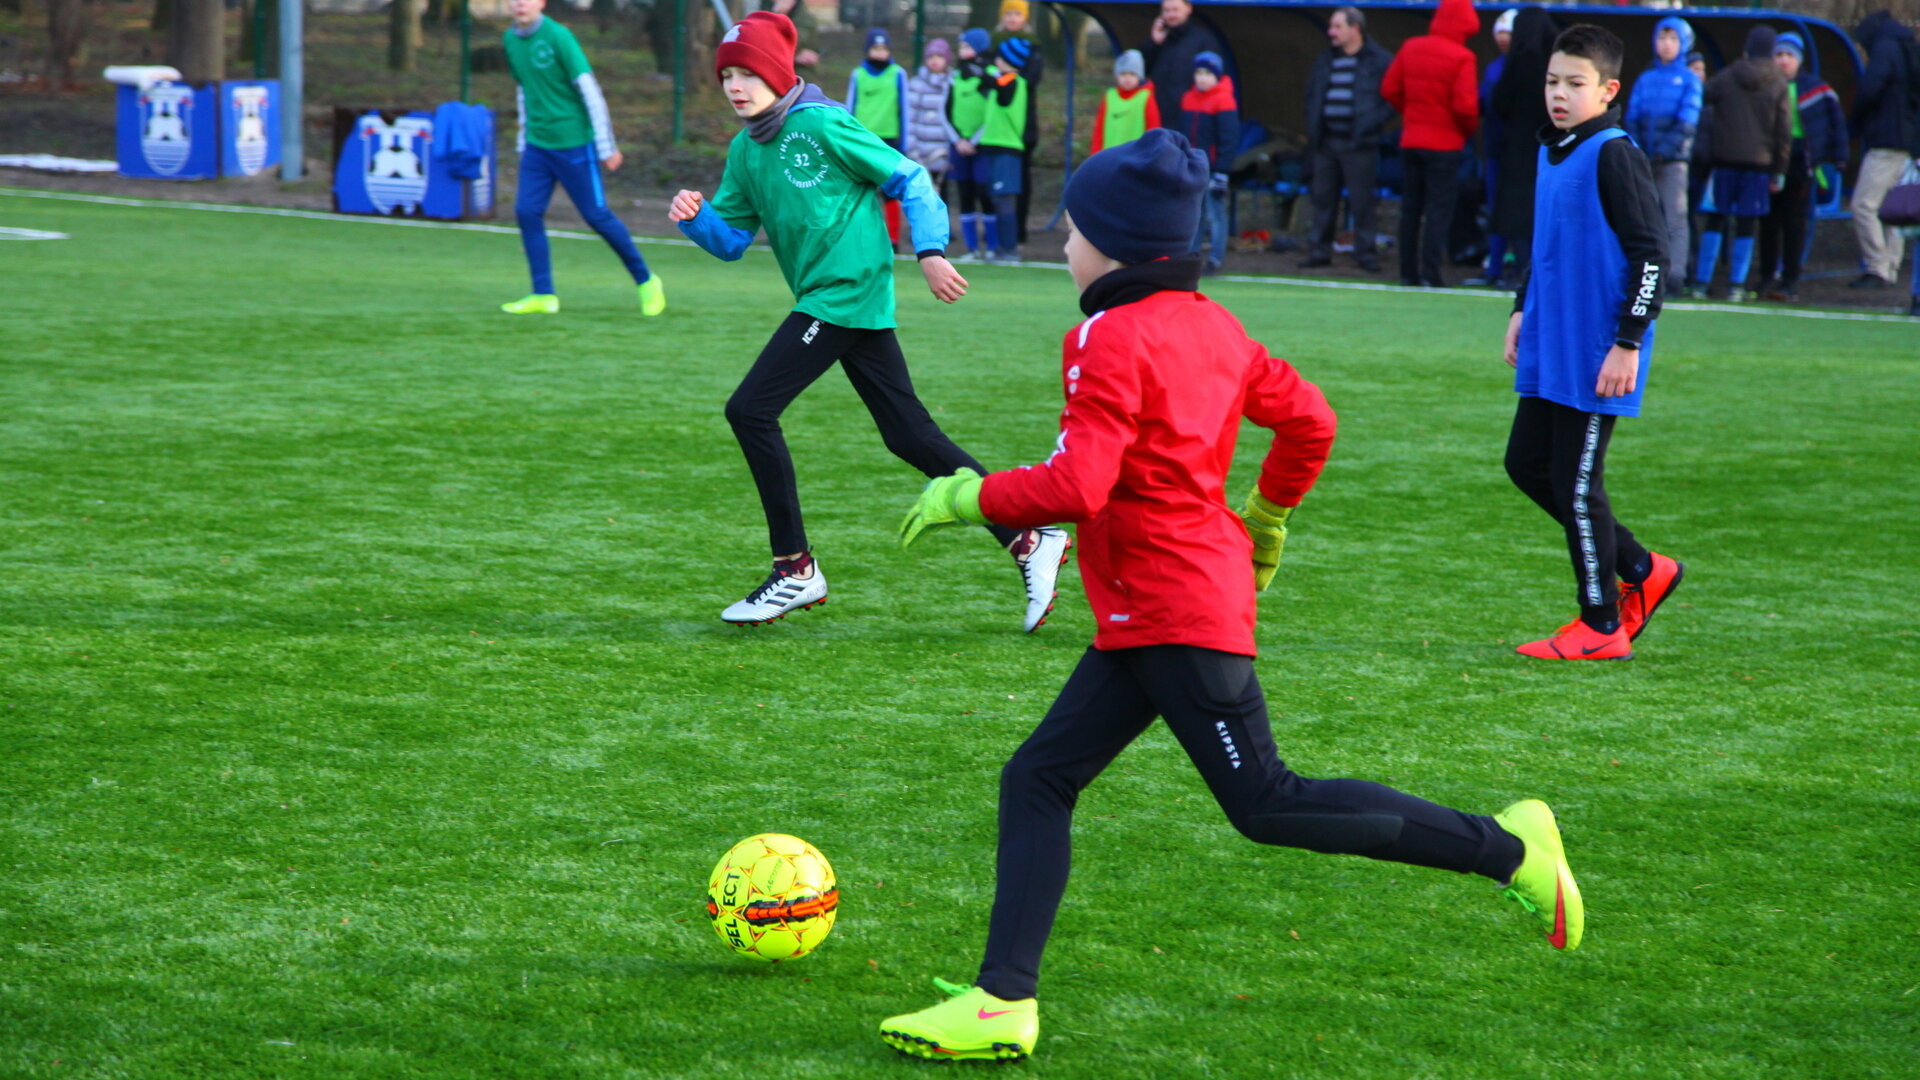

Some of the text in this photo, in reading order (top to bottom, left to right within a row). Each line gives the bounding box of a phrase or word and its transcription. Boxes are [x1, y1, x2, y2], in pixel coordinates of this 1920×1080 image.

[793, 153, 811, 168] 32
[1631, 261, 1660, 317] START
[1215, 720, 1241, 769] KIPSTA
